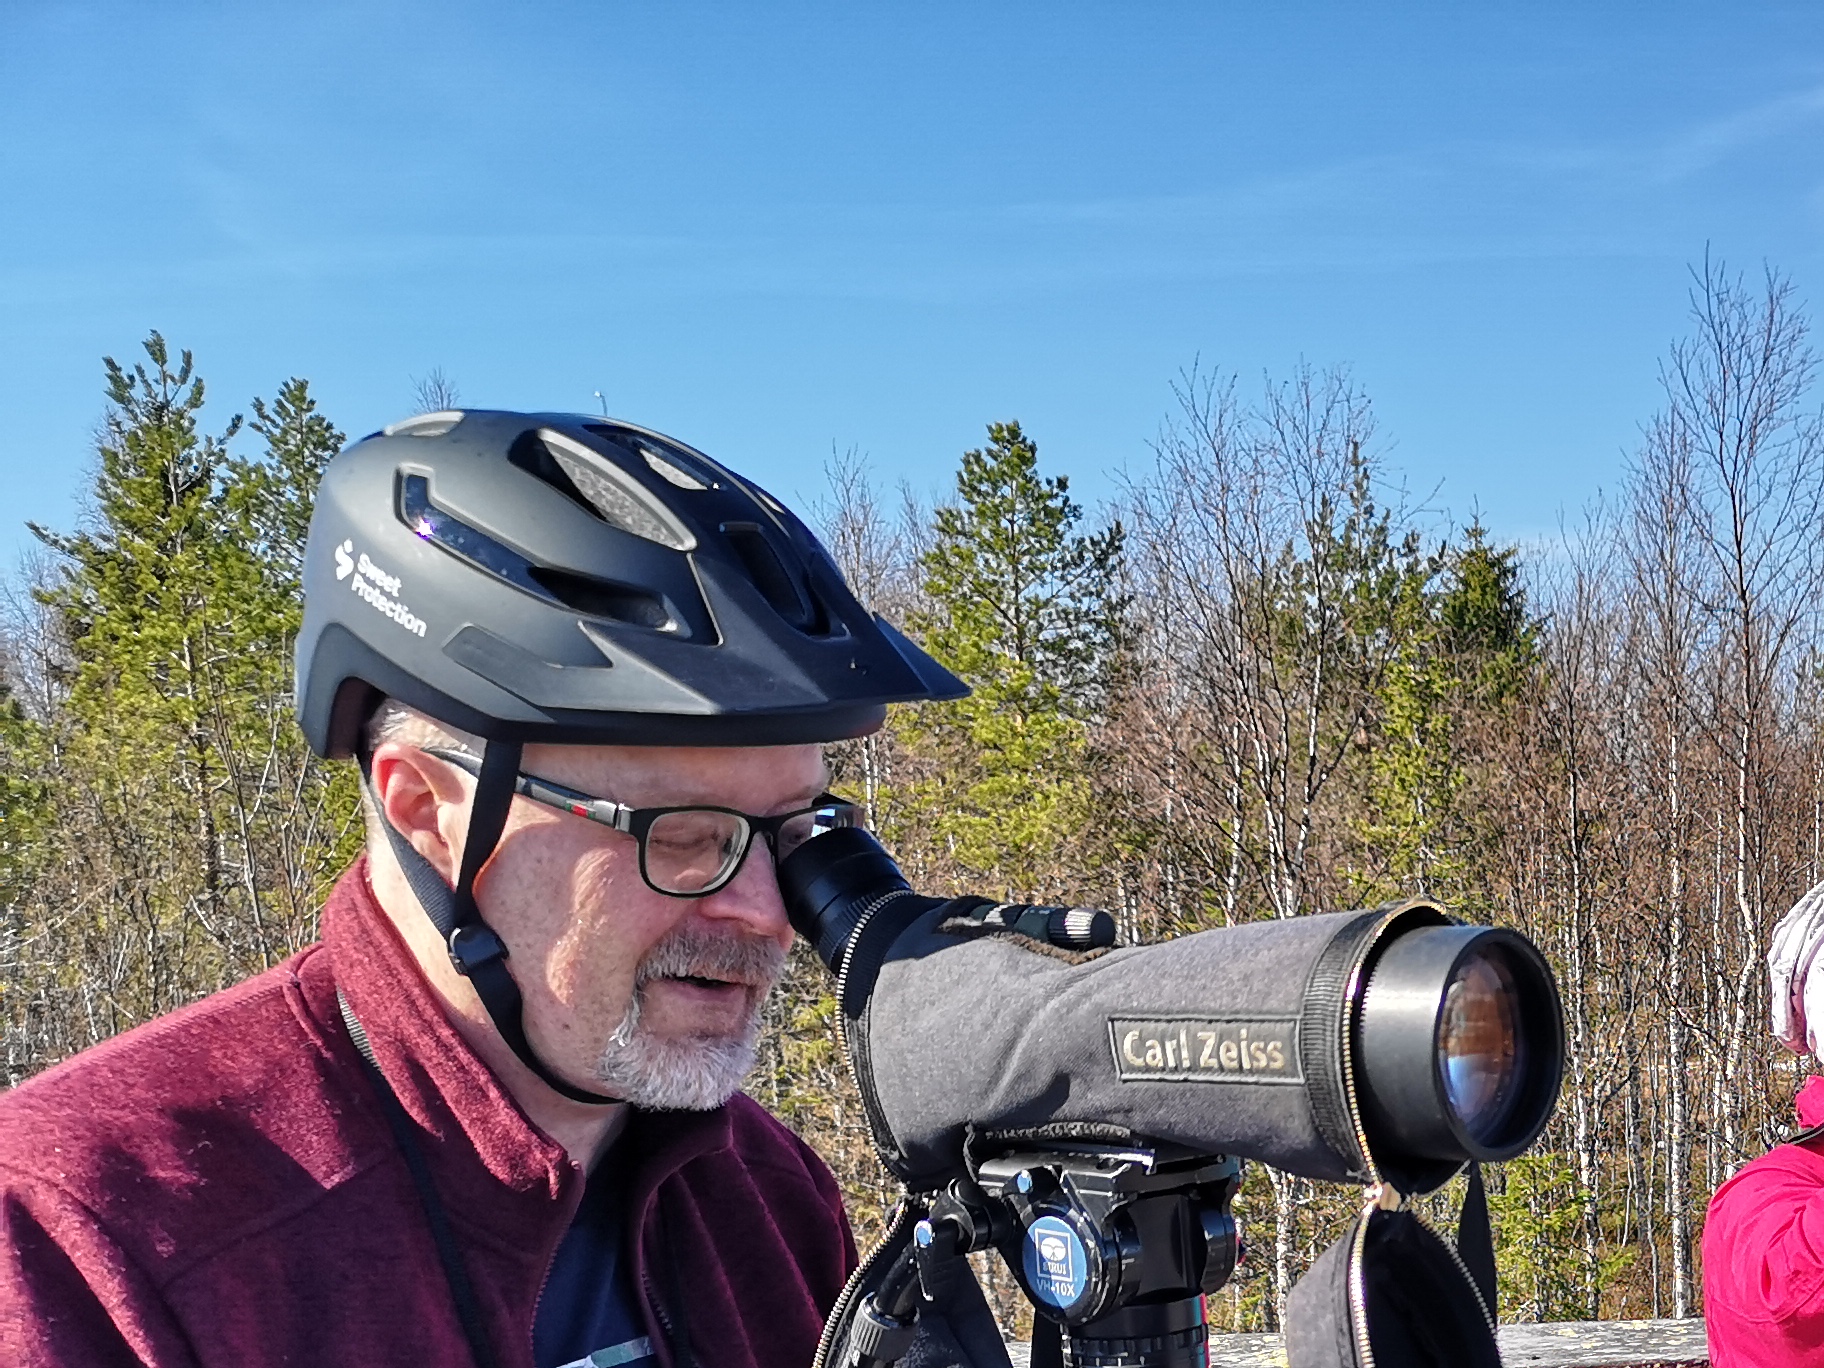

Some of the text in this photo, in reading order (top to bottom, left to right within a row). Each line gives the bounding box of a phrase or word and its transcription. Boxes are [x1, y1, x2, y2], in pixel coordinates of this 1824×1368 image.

[357, 552, 402, 598] Sweet
[351, 572, 427, 638] Protection
[1123, 1028, 1285, 1070] Carl Zeiss
[1036, 1278, 1076, 1298] VH-10X
